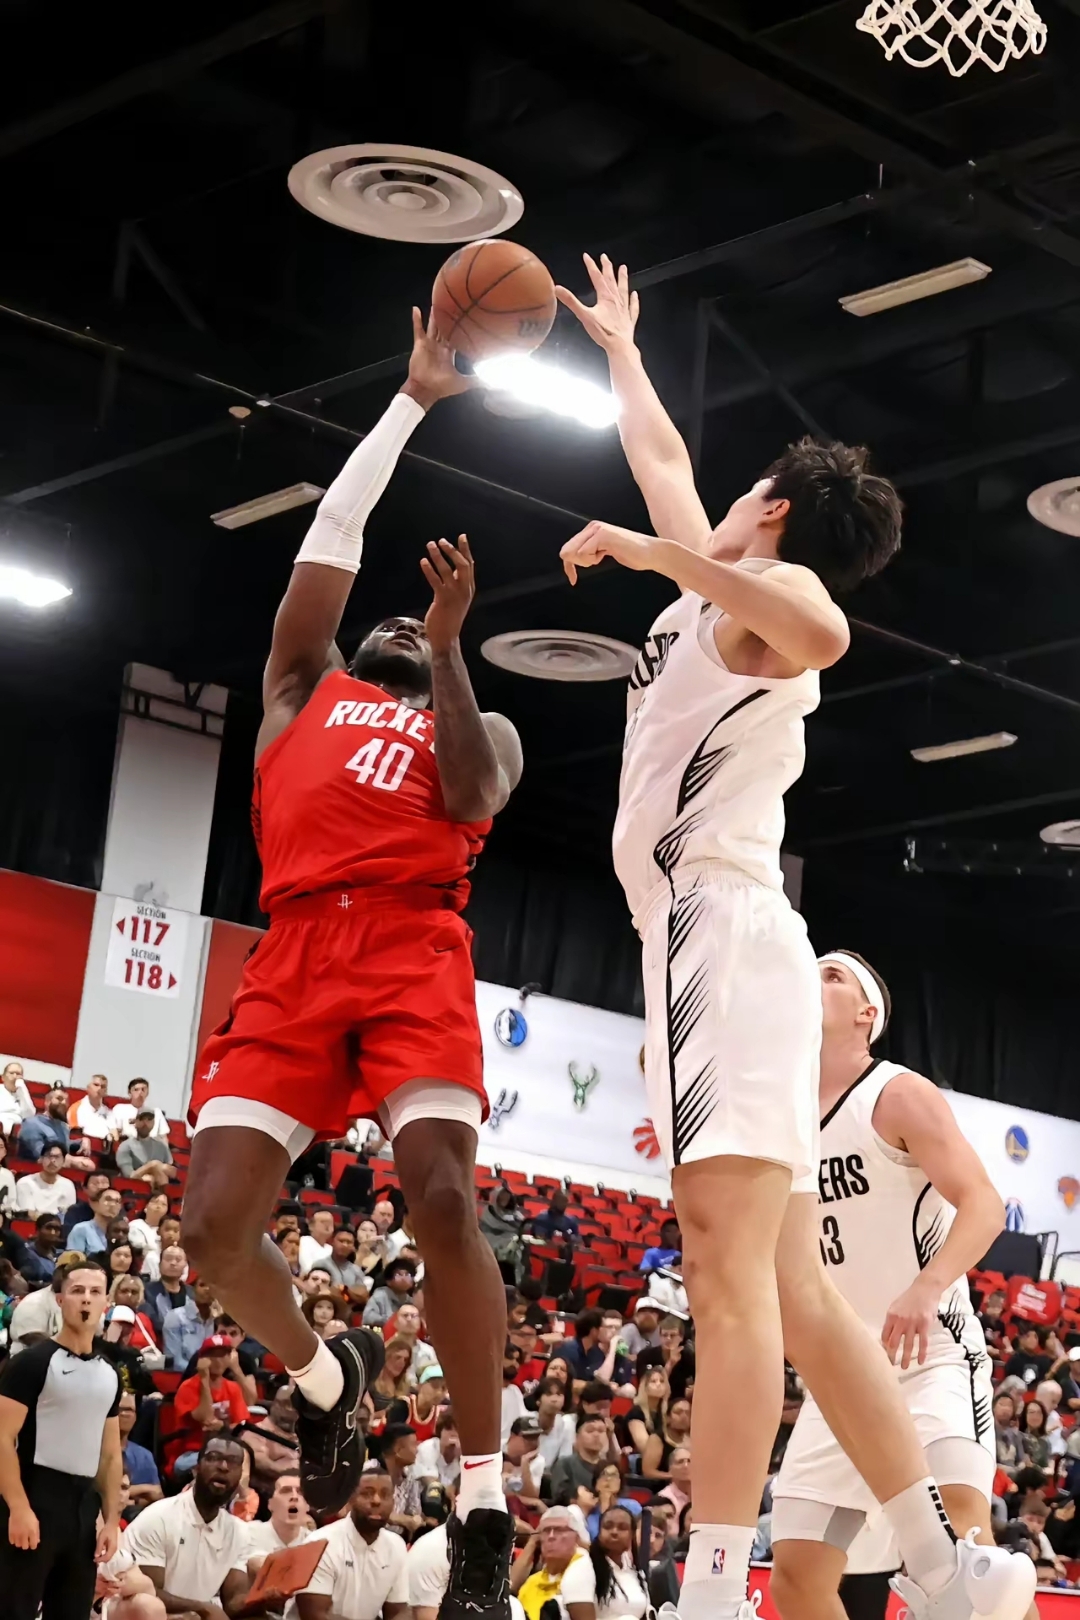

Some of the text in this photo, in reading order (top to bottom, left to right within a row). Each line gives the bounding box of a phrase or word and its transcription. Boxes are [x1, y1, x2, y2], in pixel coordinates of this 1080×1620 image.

[324, 700, 435, 753] ROCKE
[345, 738, 415, 792] 40
[131, 915, 171, 946] 117
[136, 906, 167, 919] SECTION
[124, 959, 163, 989] 118
[131, 947, 162, 962] SECTION
[818, 1154, 870, 1204] ERS
[819, 1215, 845, 1266] 3
